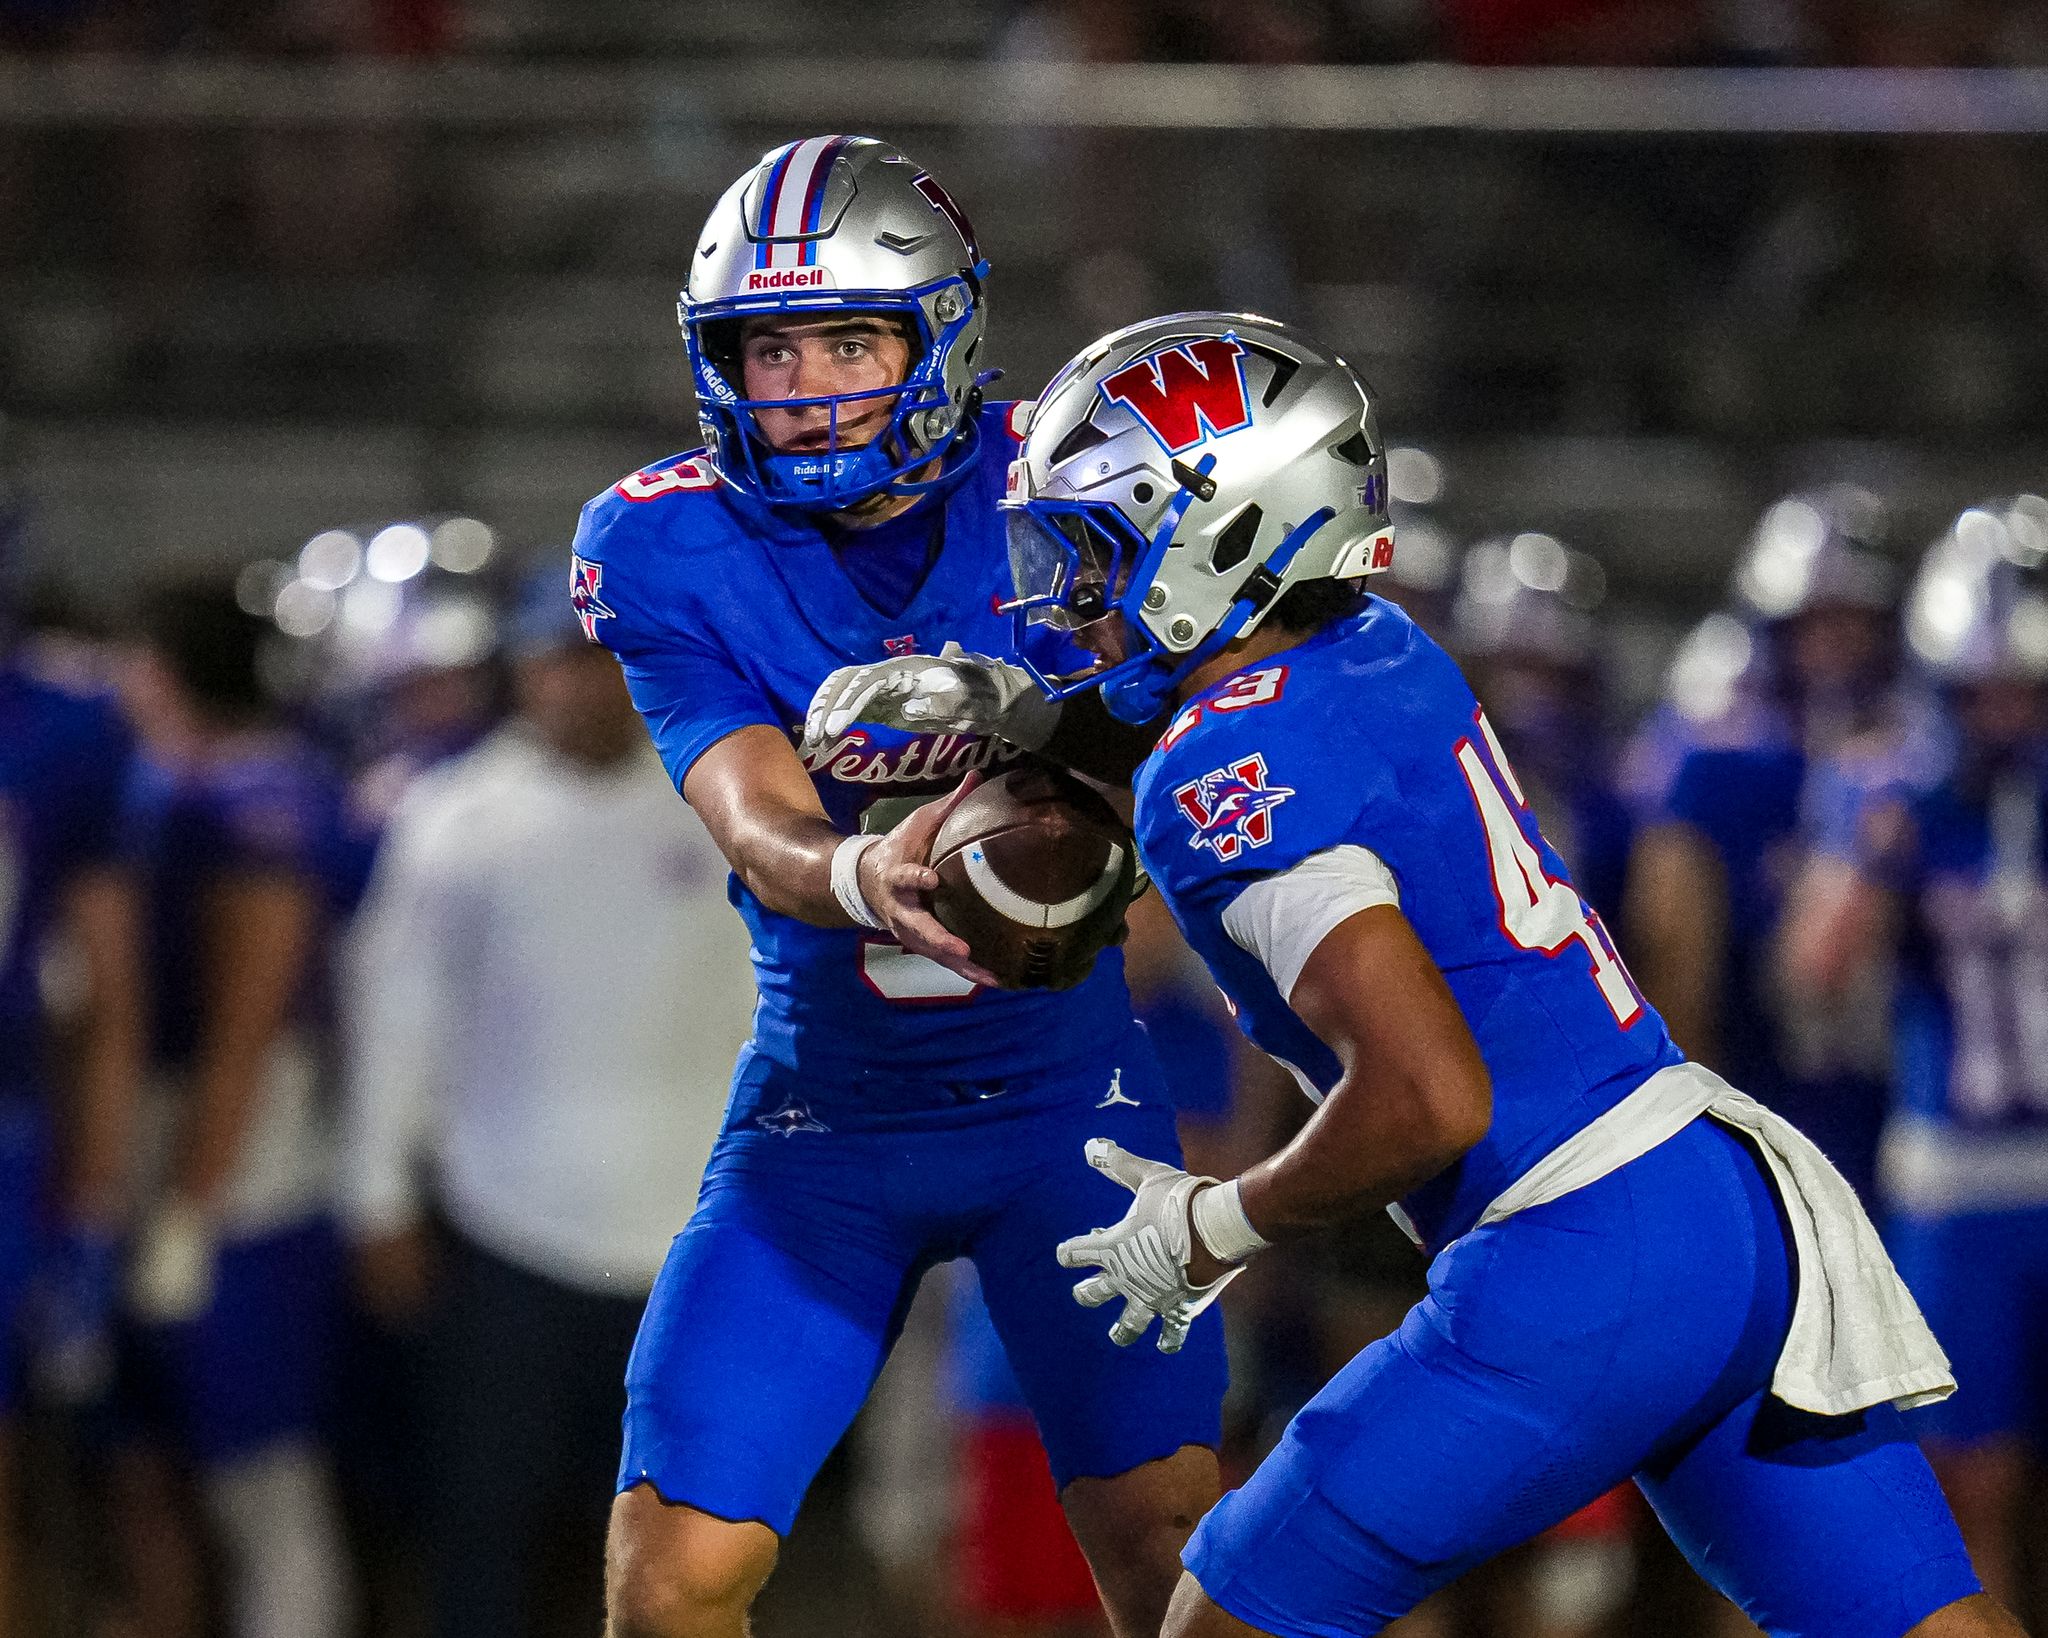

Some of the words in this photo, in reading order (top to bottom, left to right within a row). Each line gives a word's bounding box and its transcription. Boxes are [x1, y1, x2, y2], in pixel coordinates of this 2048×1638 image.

[749, 270, 823, 290] Riddell
[1096, 329, 1254, 458] W
[793, 464, 830, 475] Riddell
